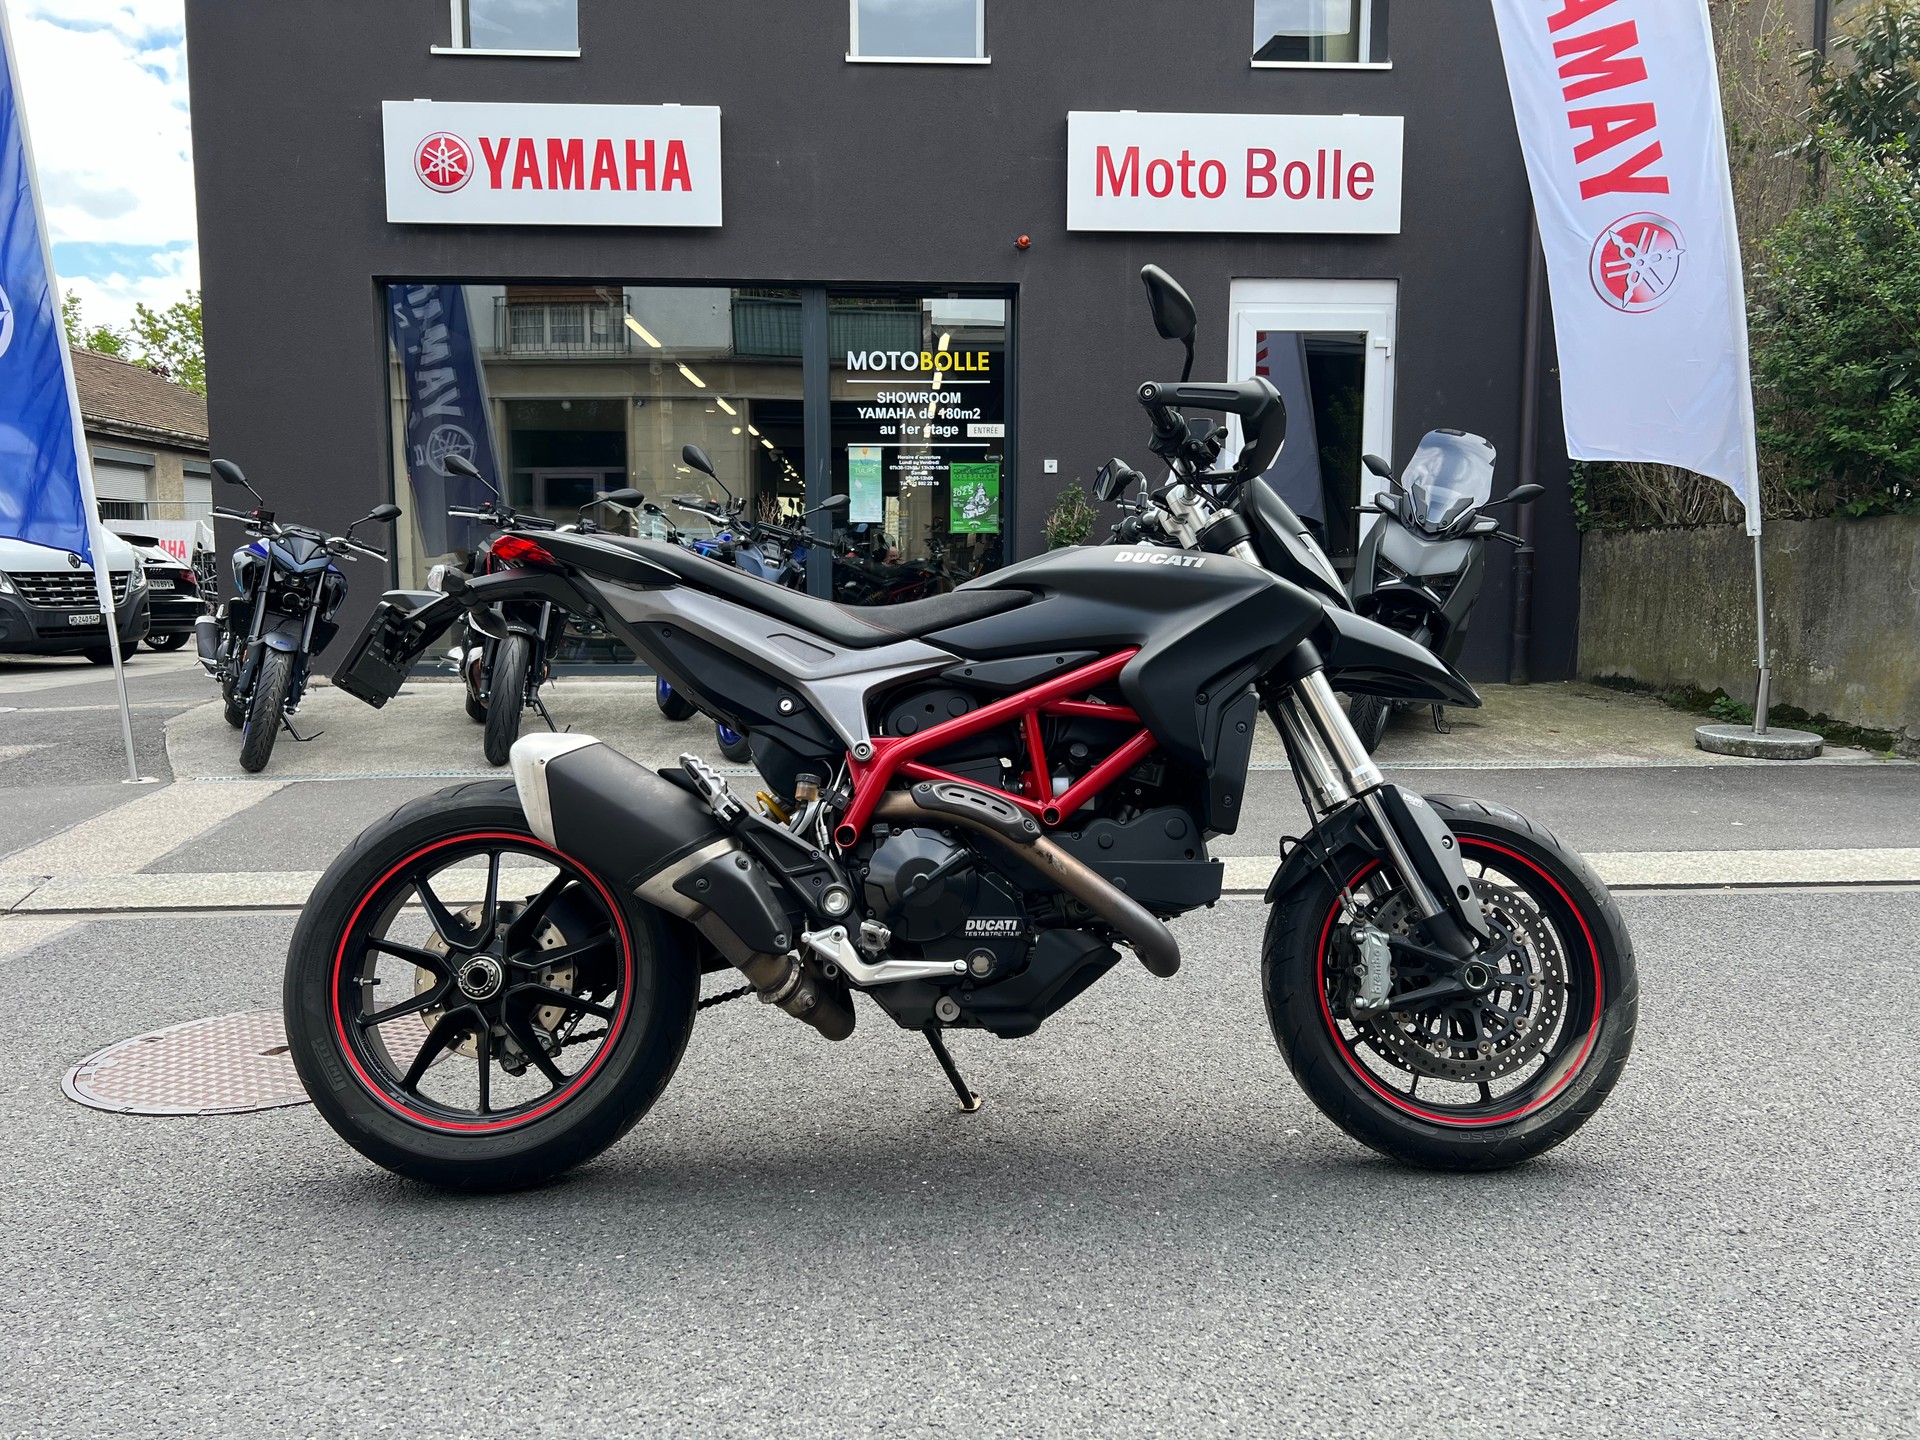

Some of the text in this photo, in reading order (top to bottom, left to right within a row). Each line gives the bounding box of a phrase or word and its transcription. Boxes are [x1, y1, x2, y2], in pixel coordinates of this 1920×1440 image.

[477, 136, 693, 192] YAMAHA
[1095, 145, 1375, 201] Moto Bolle
[847, 351, 990, 371] MOTOBOLLE
[877, 392, 961, 404] SHOWROOM
[857, 407, 981, 419] YAMAHA de 180m2
[880, 425, 895, 435] au
[900, 423, 920, 435] 1er
[973, 424, 999, 434] ENTRÉE
[1114, 551, 1207, 568] DUCATI
[965, 920, 1018, 931] DUCATI
[1370, 948, 1382, 995] brembo
[1458, 1125, 1519, 1141] ROSSO
